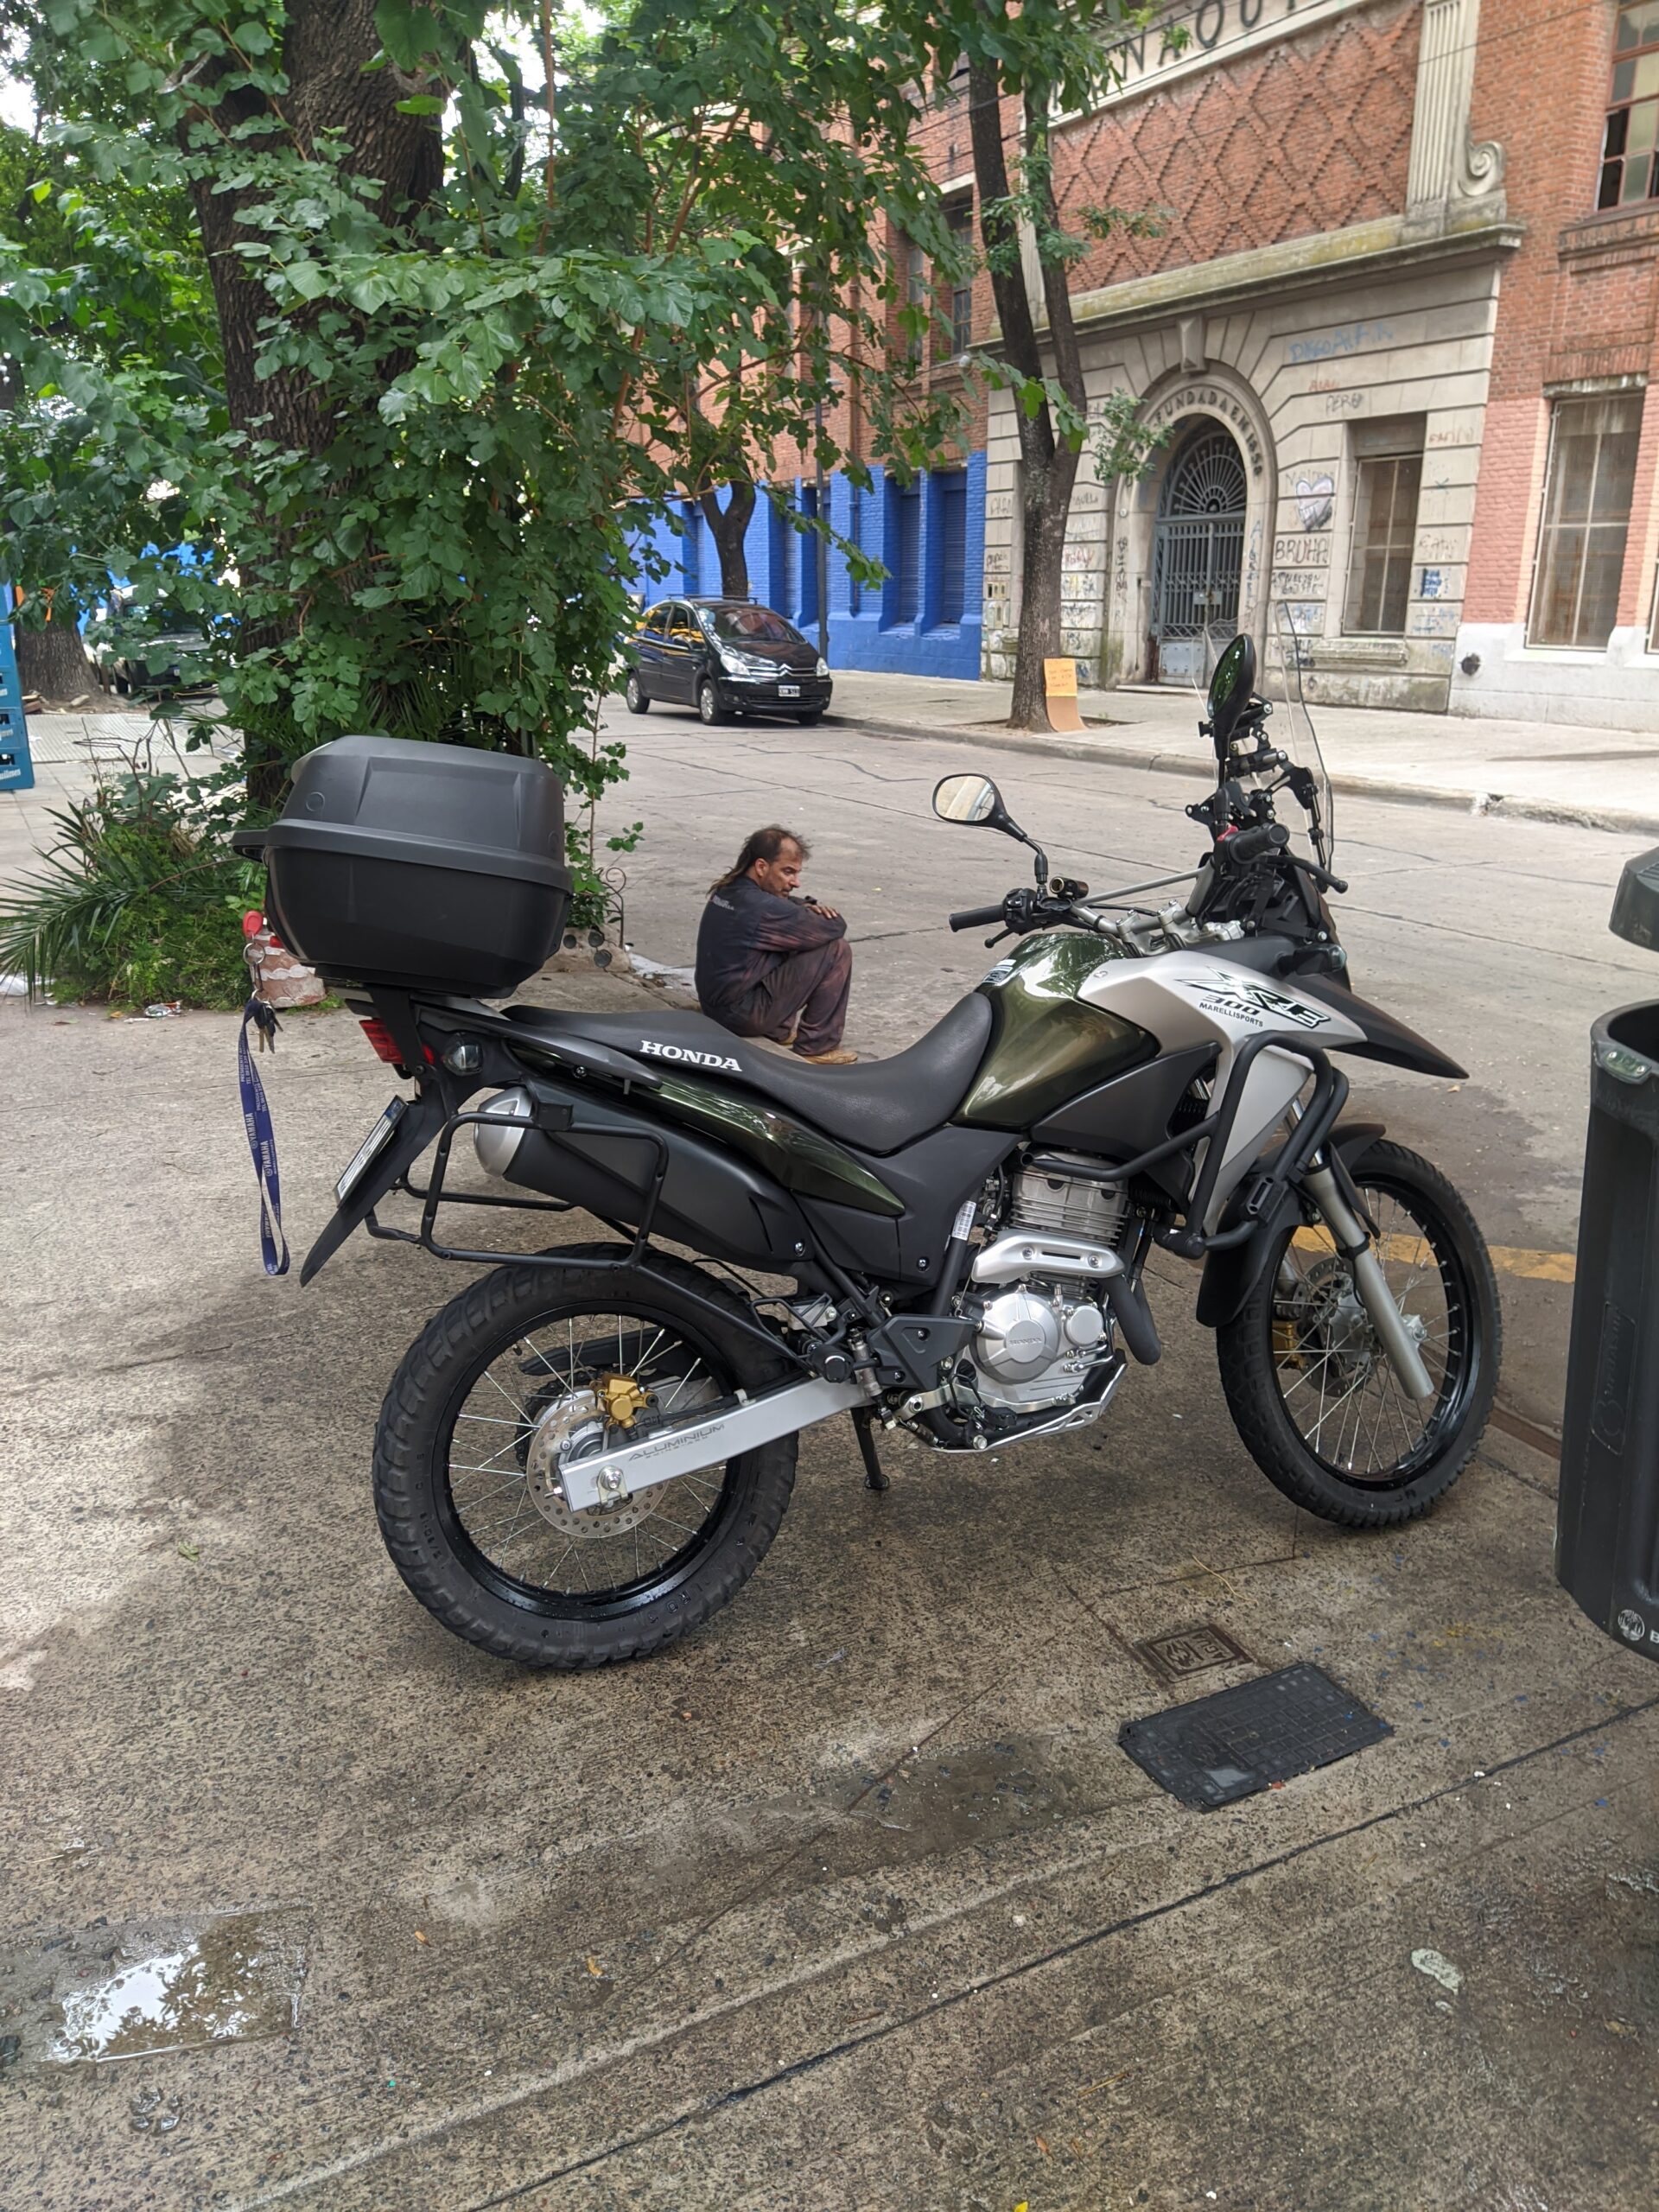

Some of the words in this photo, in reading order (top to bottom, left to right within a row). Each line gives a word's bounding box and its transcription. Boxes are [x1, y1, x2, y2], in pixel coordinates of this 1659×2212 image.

[1230, 404, 1250, 432] EN
[1173, 965, 1332, 1029] XRE
[1202, 994, 1261, 1015] 300
[1198, 1001, 1264, 1028] MARELLISPORTS
[639, 1039, 743, 1072] HONDA
[245, 1112, 257, 1141] YAMAHA
[260, 1141, 271, 1169] YAMAHA
[628, 1423, 726, 1461] ALUMINIUM
